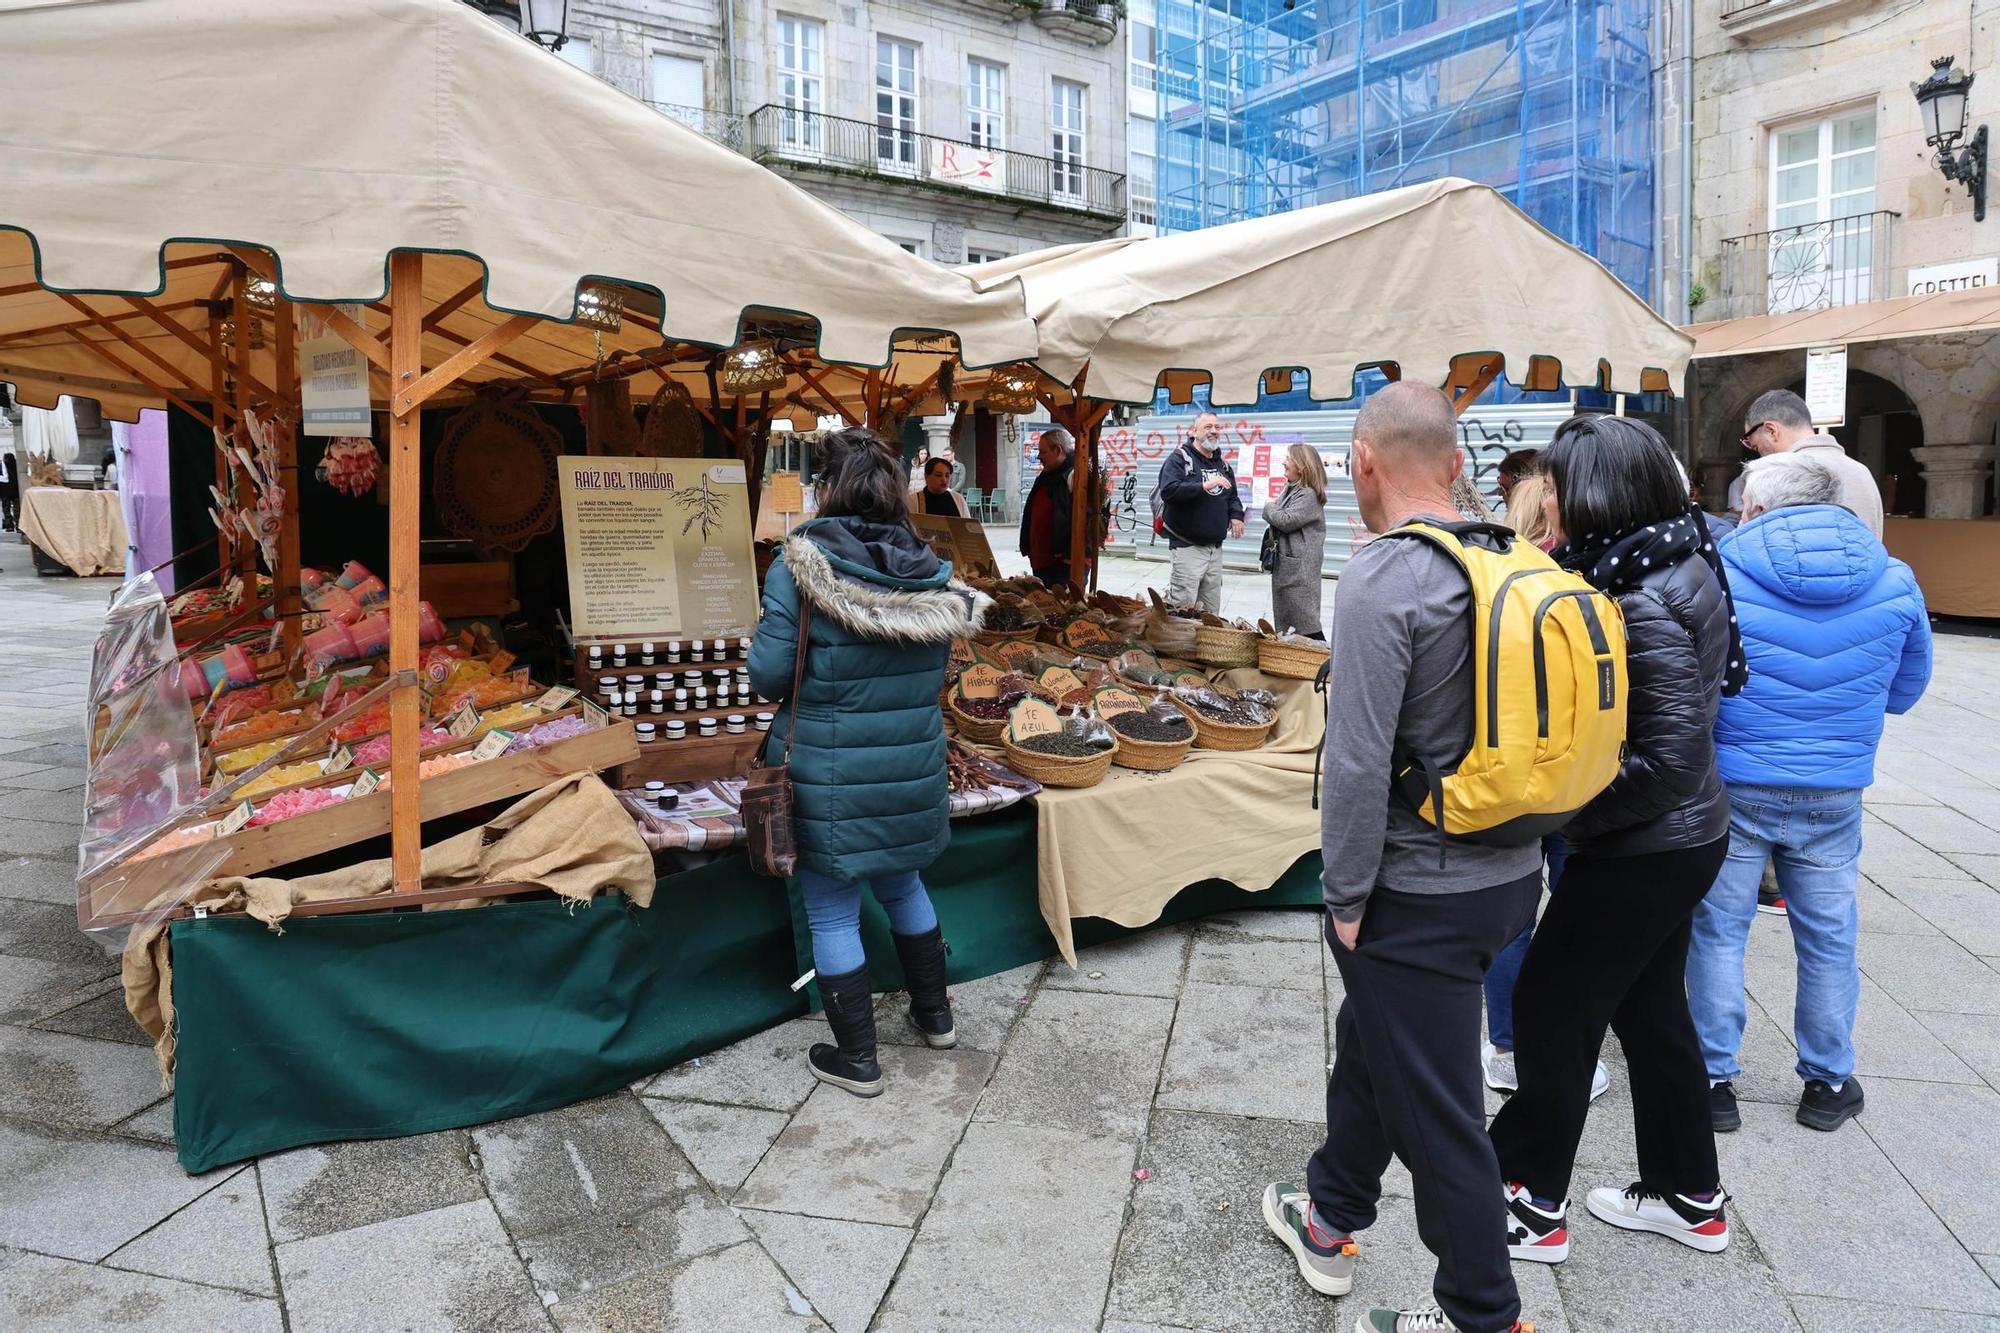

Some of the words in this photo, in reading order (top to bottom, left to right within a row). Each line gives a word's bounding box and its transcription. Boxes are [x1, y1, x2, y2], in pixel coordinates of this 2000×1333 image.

[574, 466, 602, 489] RAÍZ
[603, 471, 626, 489] DEL
[628, 471, 675, 490] TRAIDOR
[1020, 721, 1051, 733] AZUL
